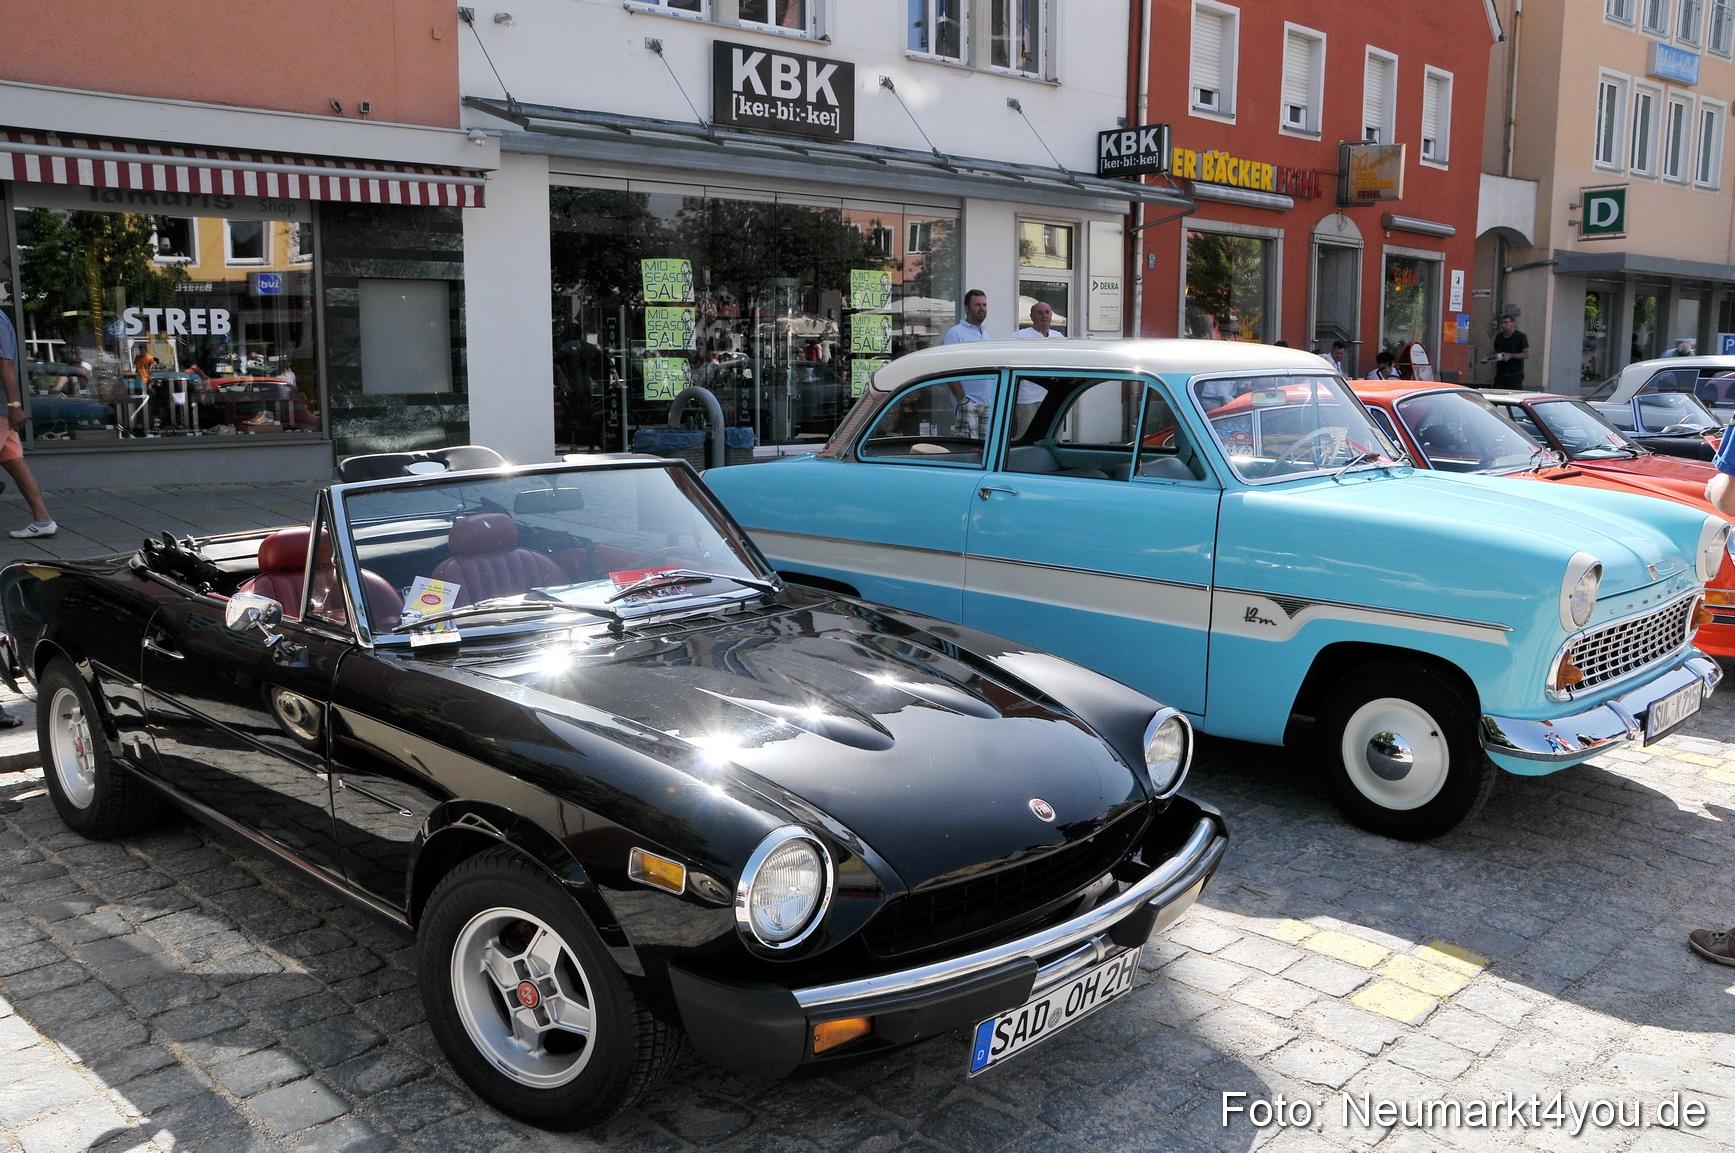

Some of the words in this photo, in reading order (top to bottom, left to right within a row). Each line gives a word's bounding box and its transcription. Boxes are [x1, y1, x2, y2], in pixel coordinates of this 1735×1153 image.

[732, 48, 840, 106] KBK
[1101, 128, 1159, 158] KBK
[1172, 147, 1197, 179] ER
[1202, 150, 1273, 191] BÄCKER
[259, 199, 296, 217] Shop
[1590, 197, 1620, 228] D
[644, 261, 668, 272] MID
[853, 271, 870, 281] MID
[1100, 281, 1120, 291] DEKRA
[647, 308, 669, 320] MID
[122, 307, 231, 336] STREB
[853, 316, 870, 326] MID
[1726, 338, 1735, 351] P
[646, 359, 669, 370] MID
[853, 361, 870, 371] MID
[990, 999, 1051, 1057] SAD
[1064, 972, 1102, 1018] OH
[1101, 952, 1139, 998] 2H
[976, 1049, 985, 1061] D
